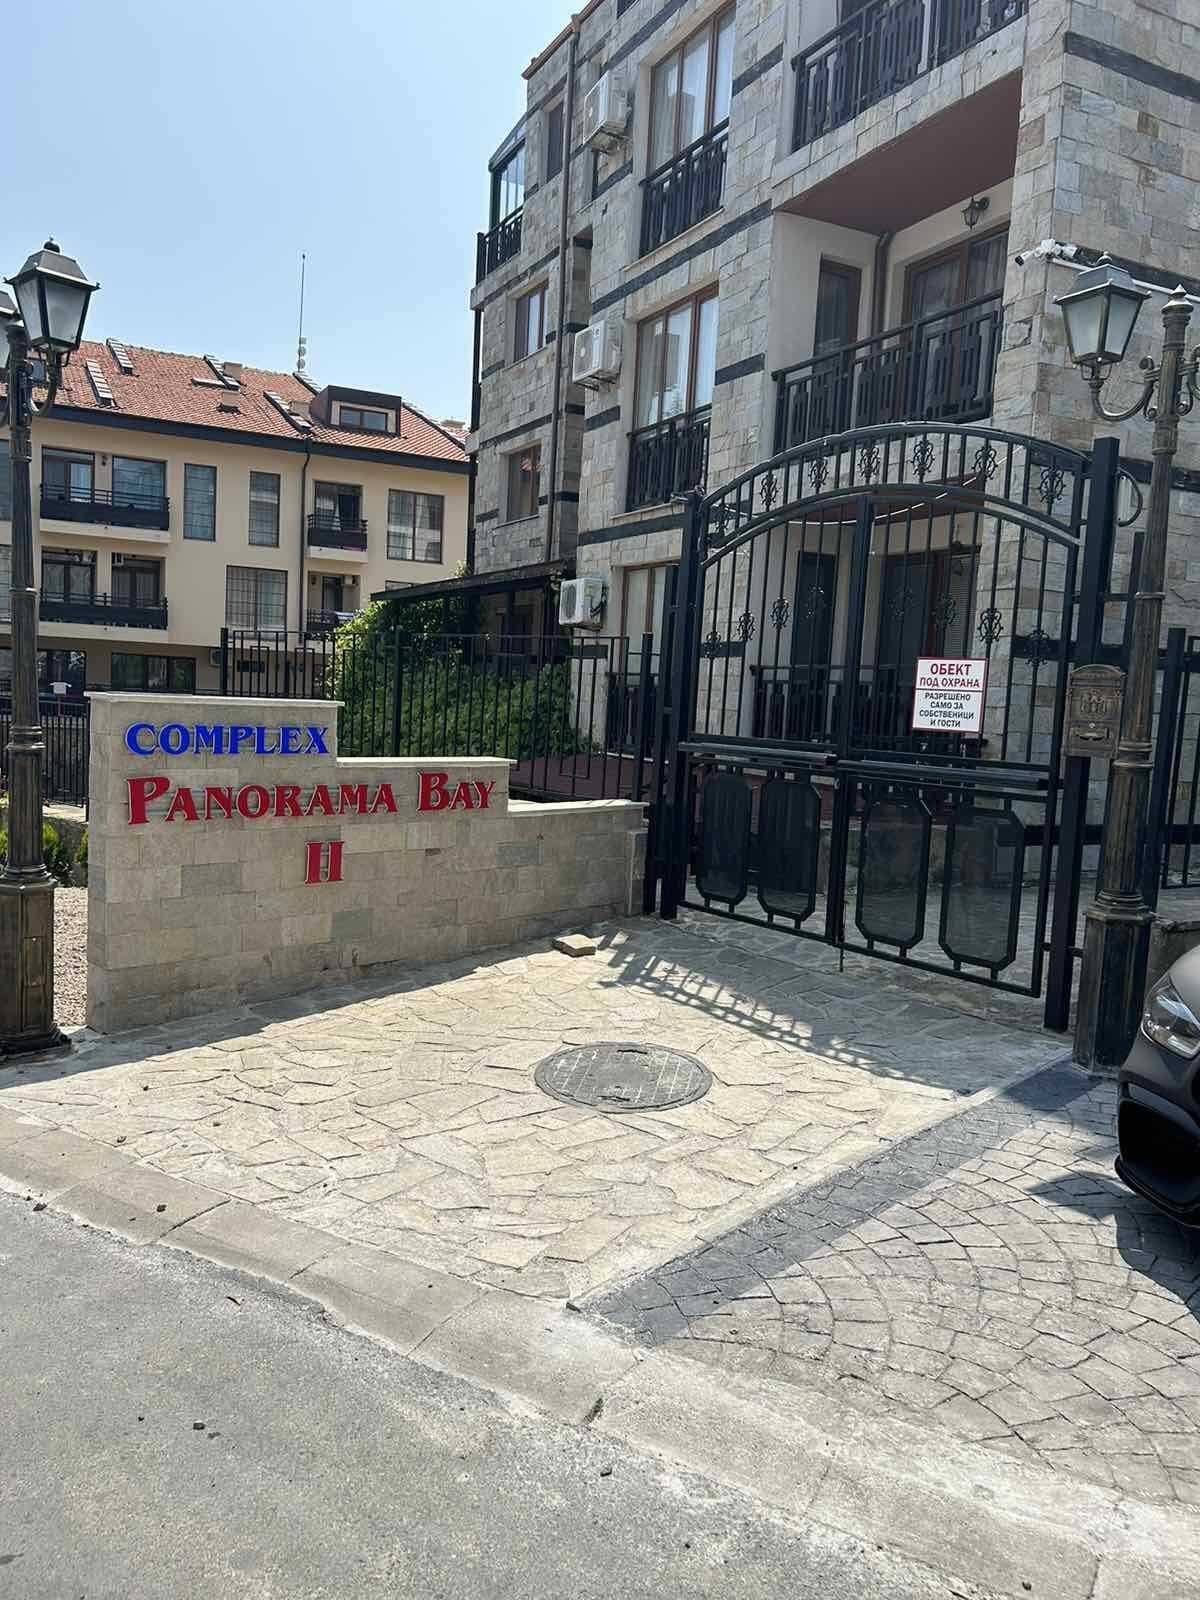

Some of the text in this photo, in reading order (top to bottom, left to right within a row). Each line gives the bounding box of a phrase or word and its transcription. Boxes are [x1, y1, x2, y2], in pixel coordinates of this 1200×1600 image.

[930, 663, 972, 676] ОБЕКТ
[920, 677, 980, 688] ПОД ОХРАНА
[924, 692, 971, 701] РАЗРЕШЕНО
[930, 701, 964, 710] САМО ЗА
[919, 709, 975, 720] СОБСТВЕНИЦИ
[937, 719, 961, 728] ГОСТИ
[124, 722, 330, 756] COMPLEX
[126, 769, 497, 825] PANORAMA BAY
[304, 840, 346, 885] II
